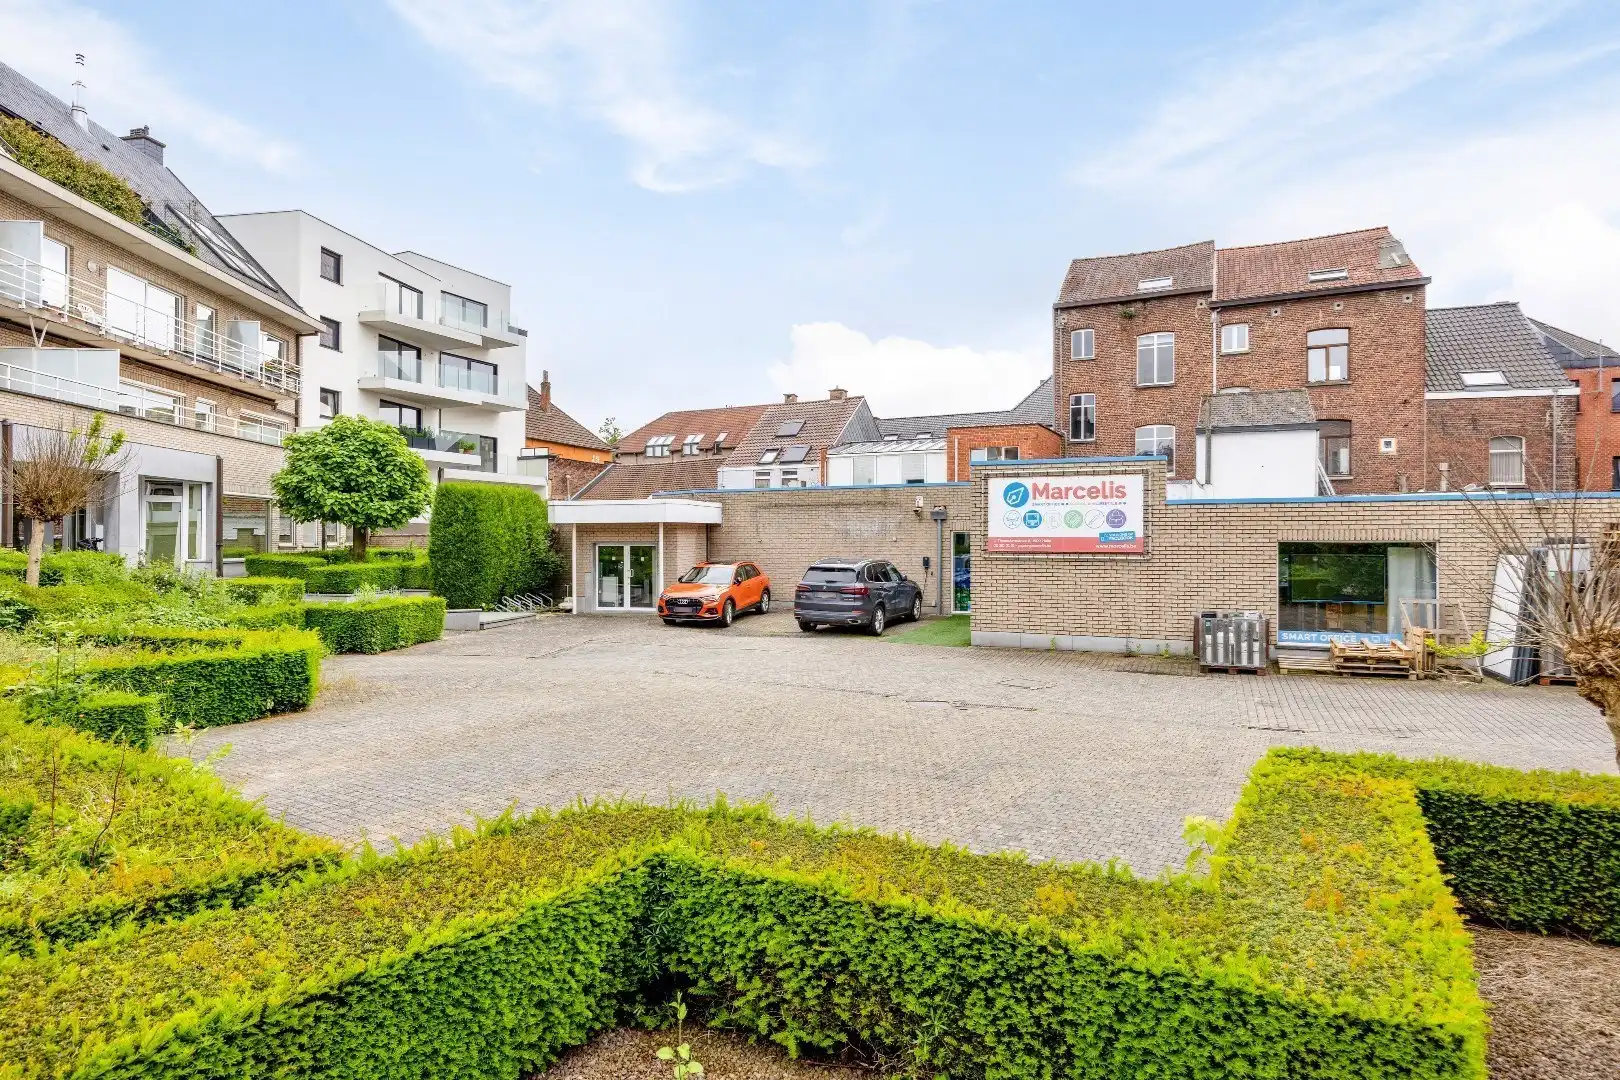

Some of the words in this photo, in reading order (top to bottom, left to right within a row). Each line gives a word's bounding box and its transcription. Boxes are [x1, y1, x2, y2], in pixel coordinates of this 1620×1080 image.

[1031, 481, 1127, 500] Marcelis
[1281, 632, 1317, 642] SMART
[1319, 634, 1357, 643] OFFICE
